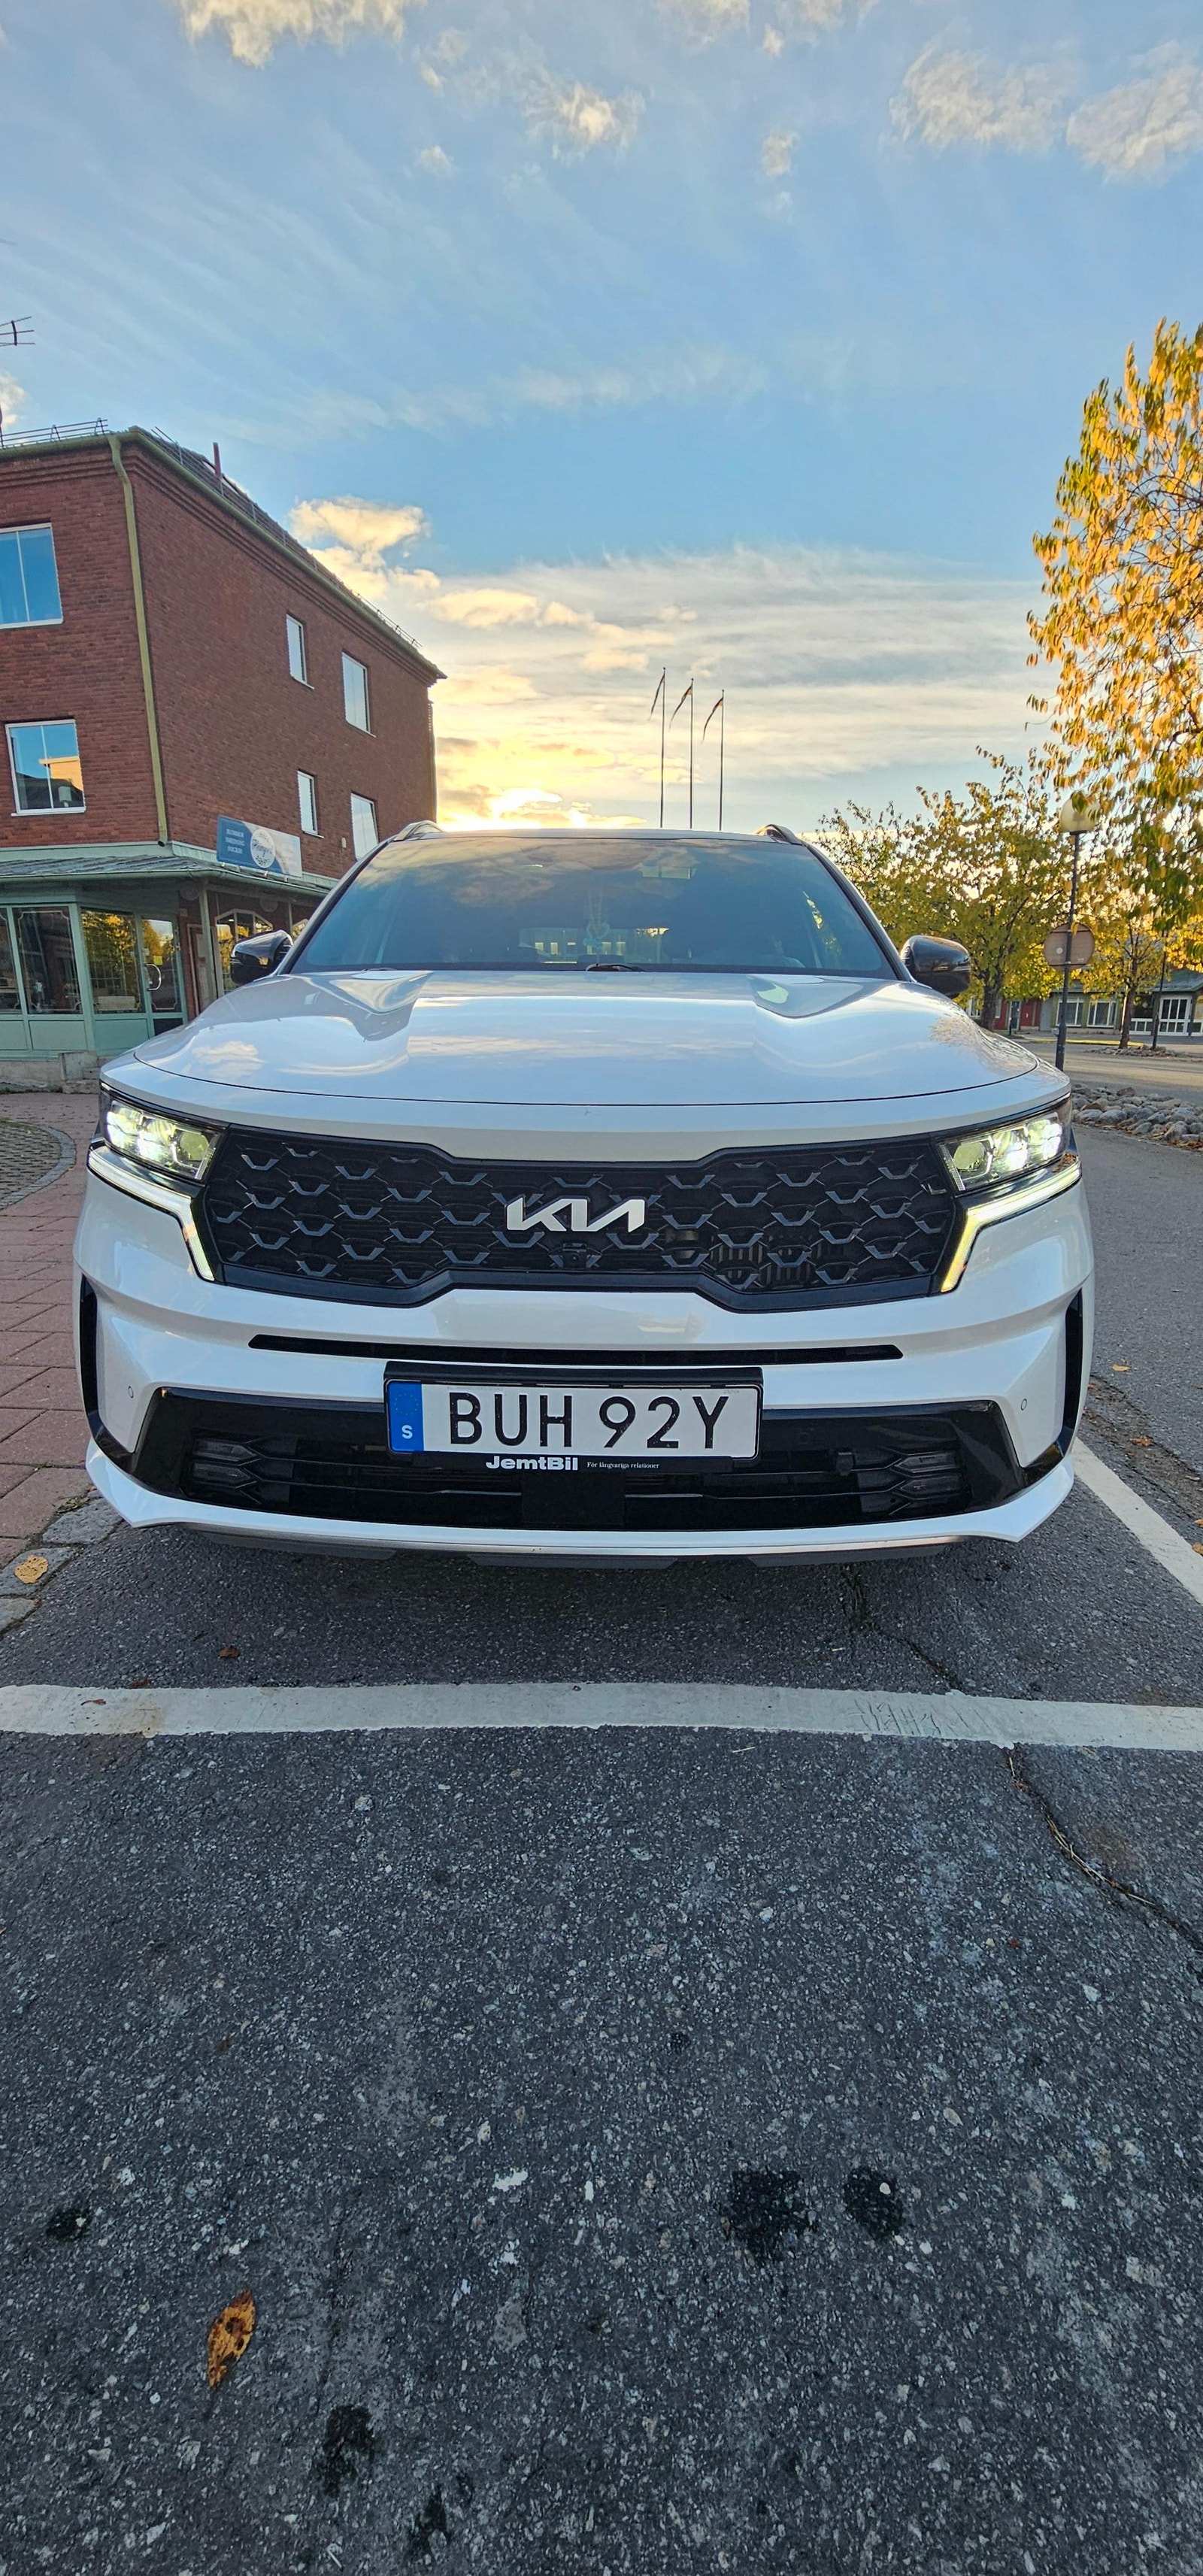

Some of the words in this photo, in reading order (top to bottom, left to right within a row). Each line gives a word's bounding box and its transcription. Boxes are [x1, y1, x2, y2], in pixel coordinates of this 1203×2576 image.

[507, 1197, 645, 1232] KIA
[449, 1392, 572, 1447] BUH
[598, 1396, 729, 1449] 92Y
[402, 1424, 413, 1439] S
[486, 1456, 578, 1471] JemtBil
[598, 1461, 629, 1470] långvariga
